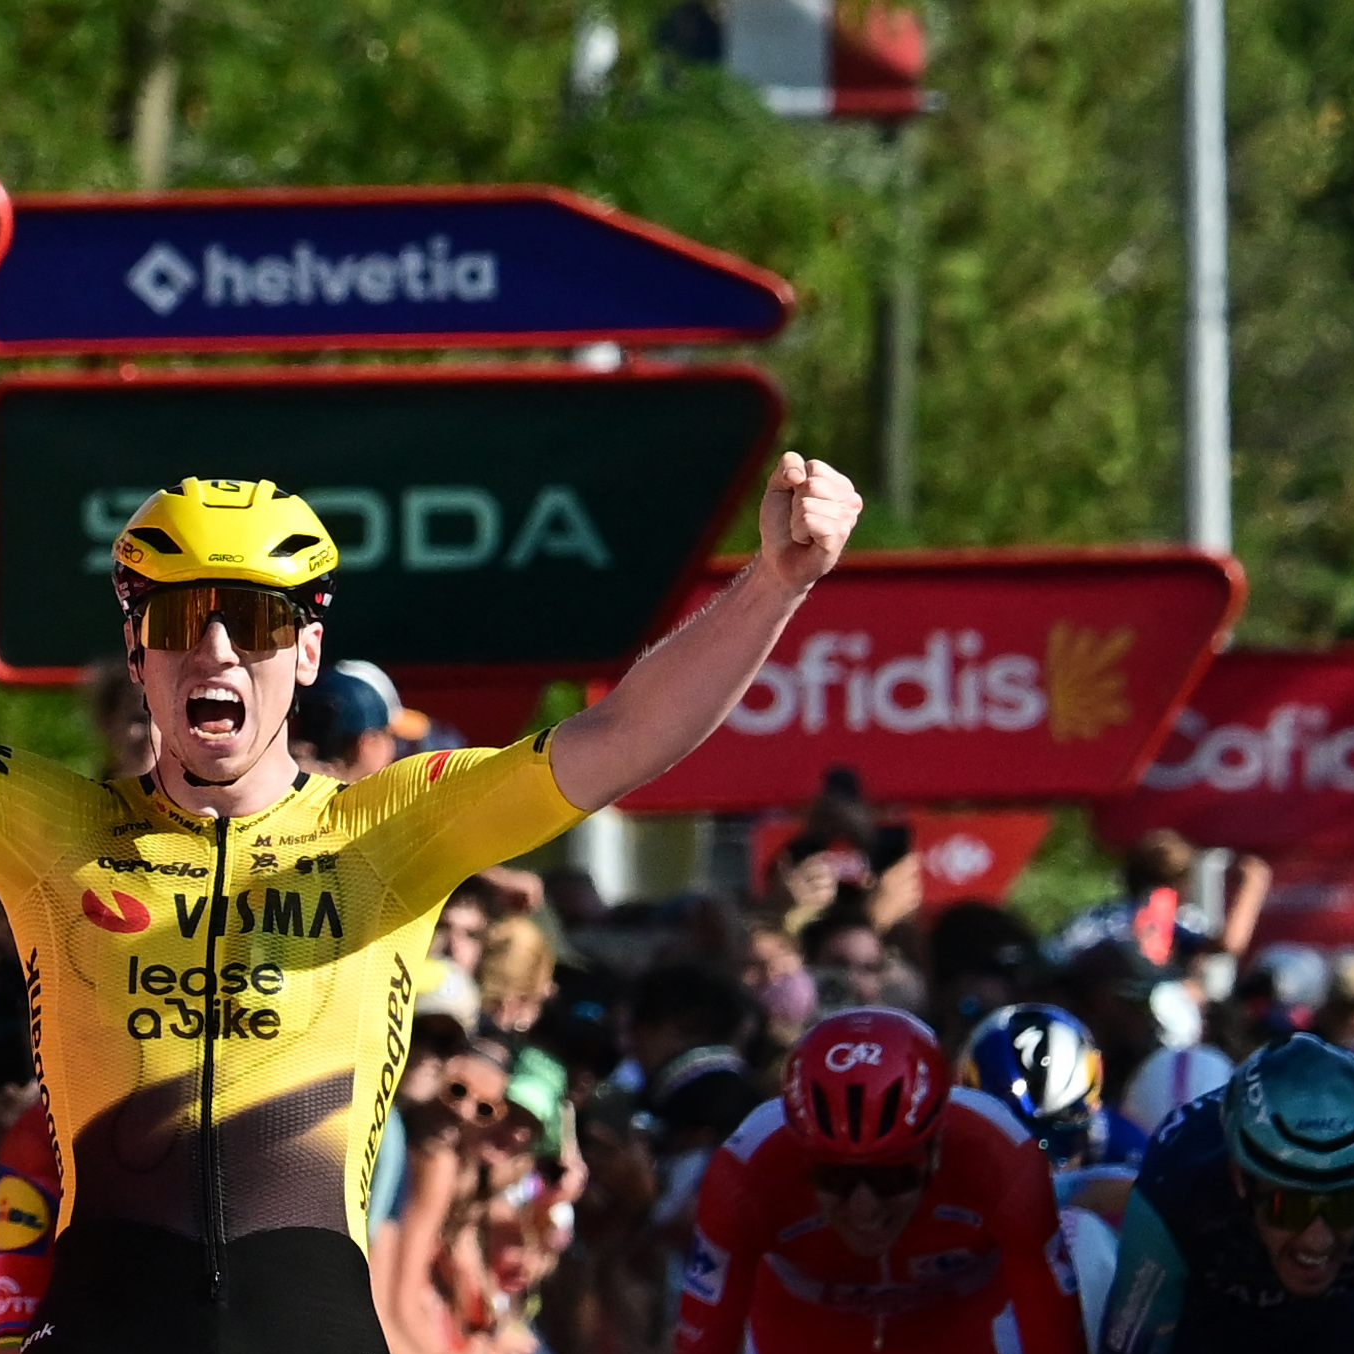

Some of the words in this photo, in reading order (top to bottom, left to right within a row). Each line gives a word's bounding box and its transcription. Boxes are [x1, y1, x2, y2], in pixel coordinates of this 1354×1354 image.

[204, 232, 498, 306] helvetia
[81, 487, 612, 574] SODA
[208, 553, 245, 563] GIRO
[721, 629, 1048, 737] ofidis
[278, 831, 317, 846] Mistral
[174, 888, 344, 939] VISMA
[128, 955, 285, 997] lease
